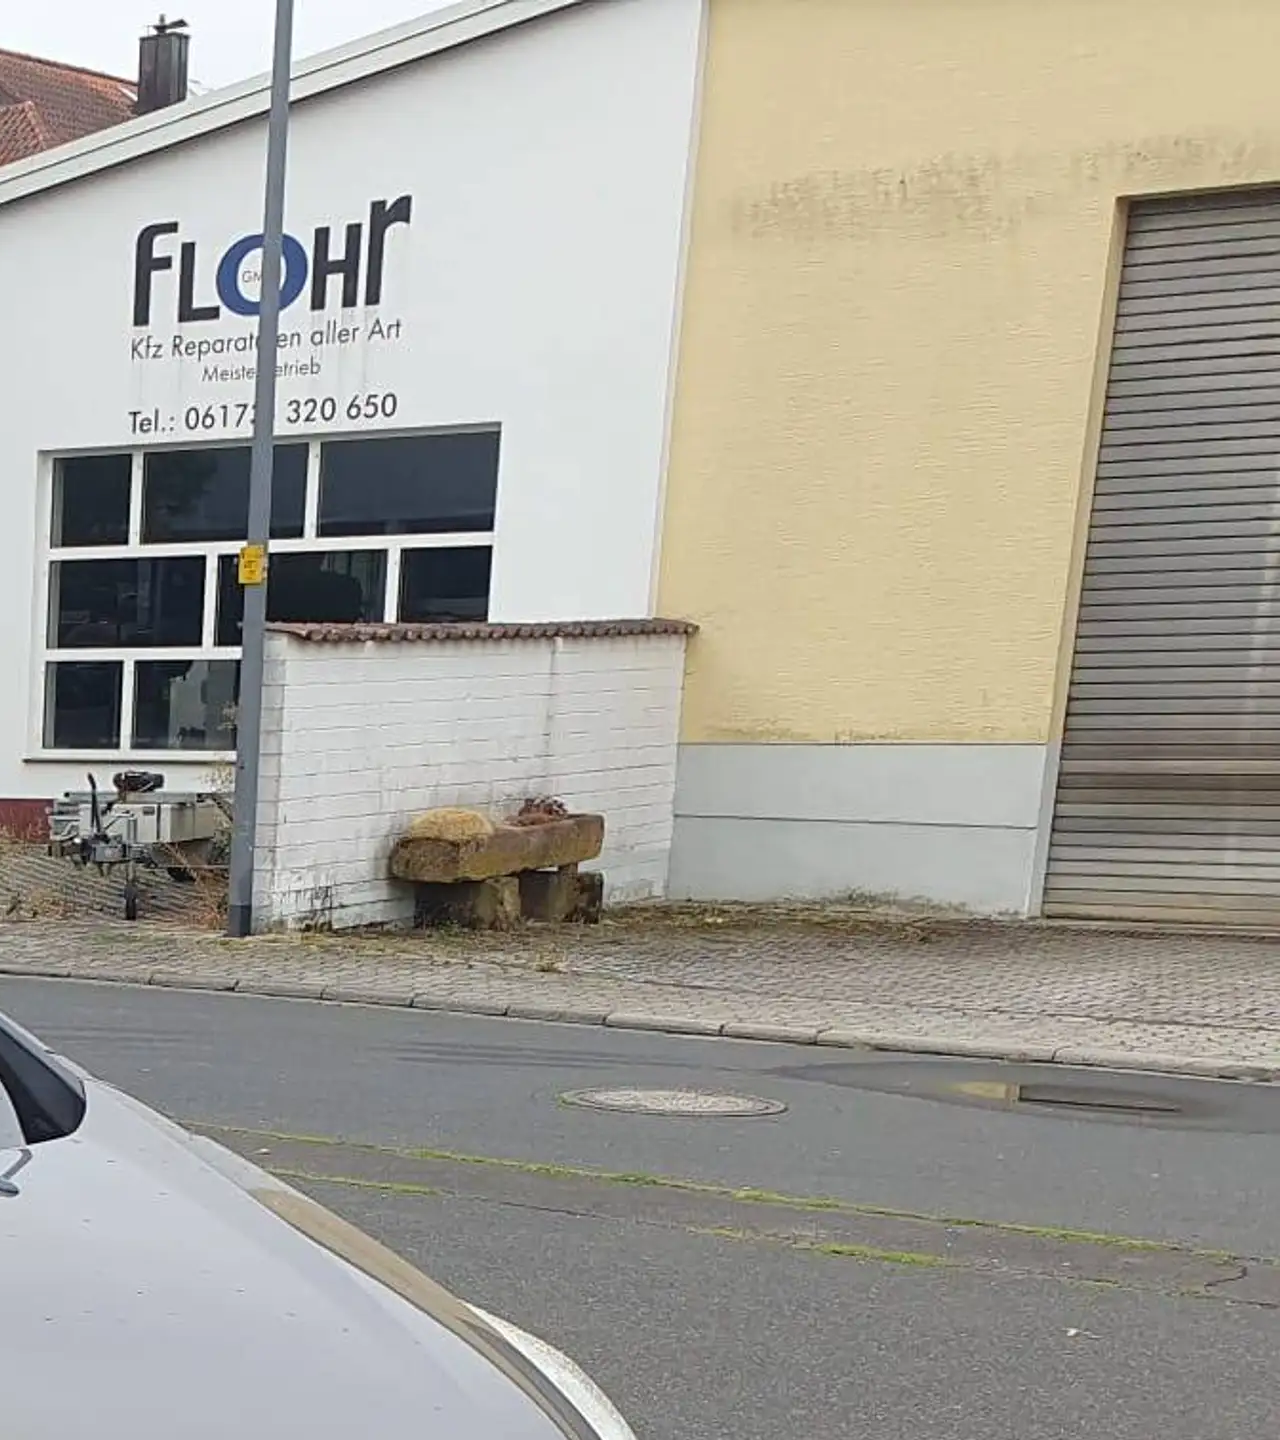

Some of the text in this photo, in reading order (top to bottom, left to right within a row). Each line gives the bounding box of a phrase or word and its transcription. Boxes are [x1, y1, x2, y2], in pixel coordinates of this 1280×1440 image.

[131, 317, 402, 362] Kfz Reparaten aller Art
[202, 356, 321, 382] Meisteetrieb
[128, 408, 175, 434] Tel.:
[286, 397, 336, 424] 320
[346, 393, 397, 420] 650
